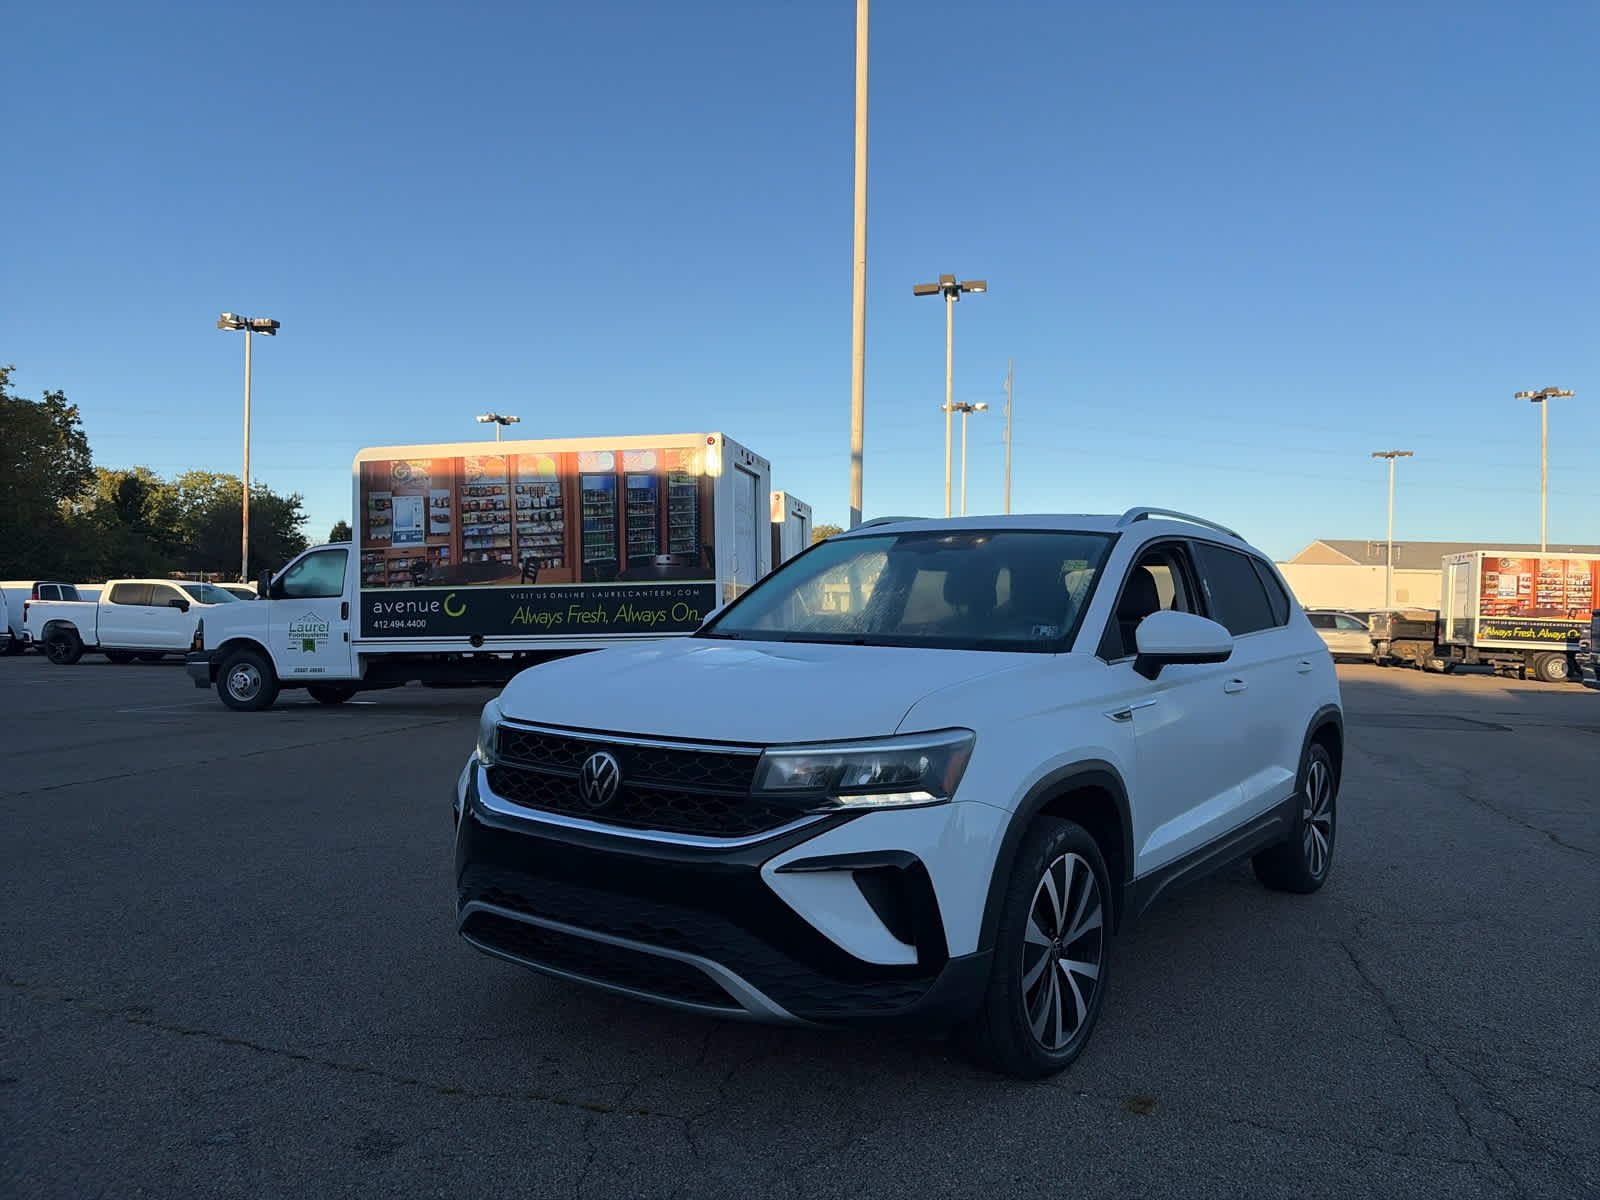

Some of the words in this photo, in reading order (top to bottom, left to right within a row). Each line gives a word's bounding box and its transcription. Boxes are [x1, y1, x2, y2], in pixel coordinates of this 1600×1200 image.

[510, 592, 534, 600] VISIT
[373, 601, 440, 614] avenue
[511, 605, 564, 629] Always
[567, 603, 609, 625] Fresh,
[613, 603, 667, 626] Always
[288, 621, 330, 633] Laurel
[373, 620, 427, 630] 412.494.4400
[1485, 626, 1512, 638] Always
[1537, 628, 1567, 640] Always
